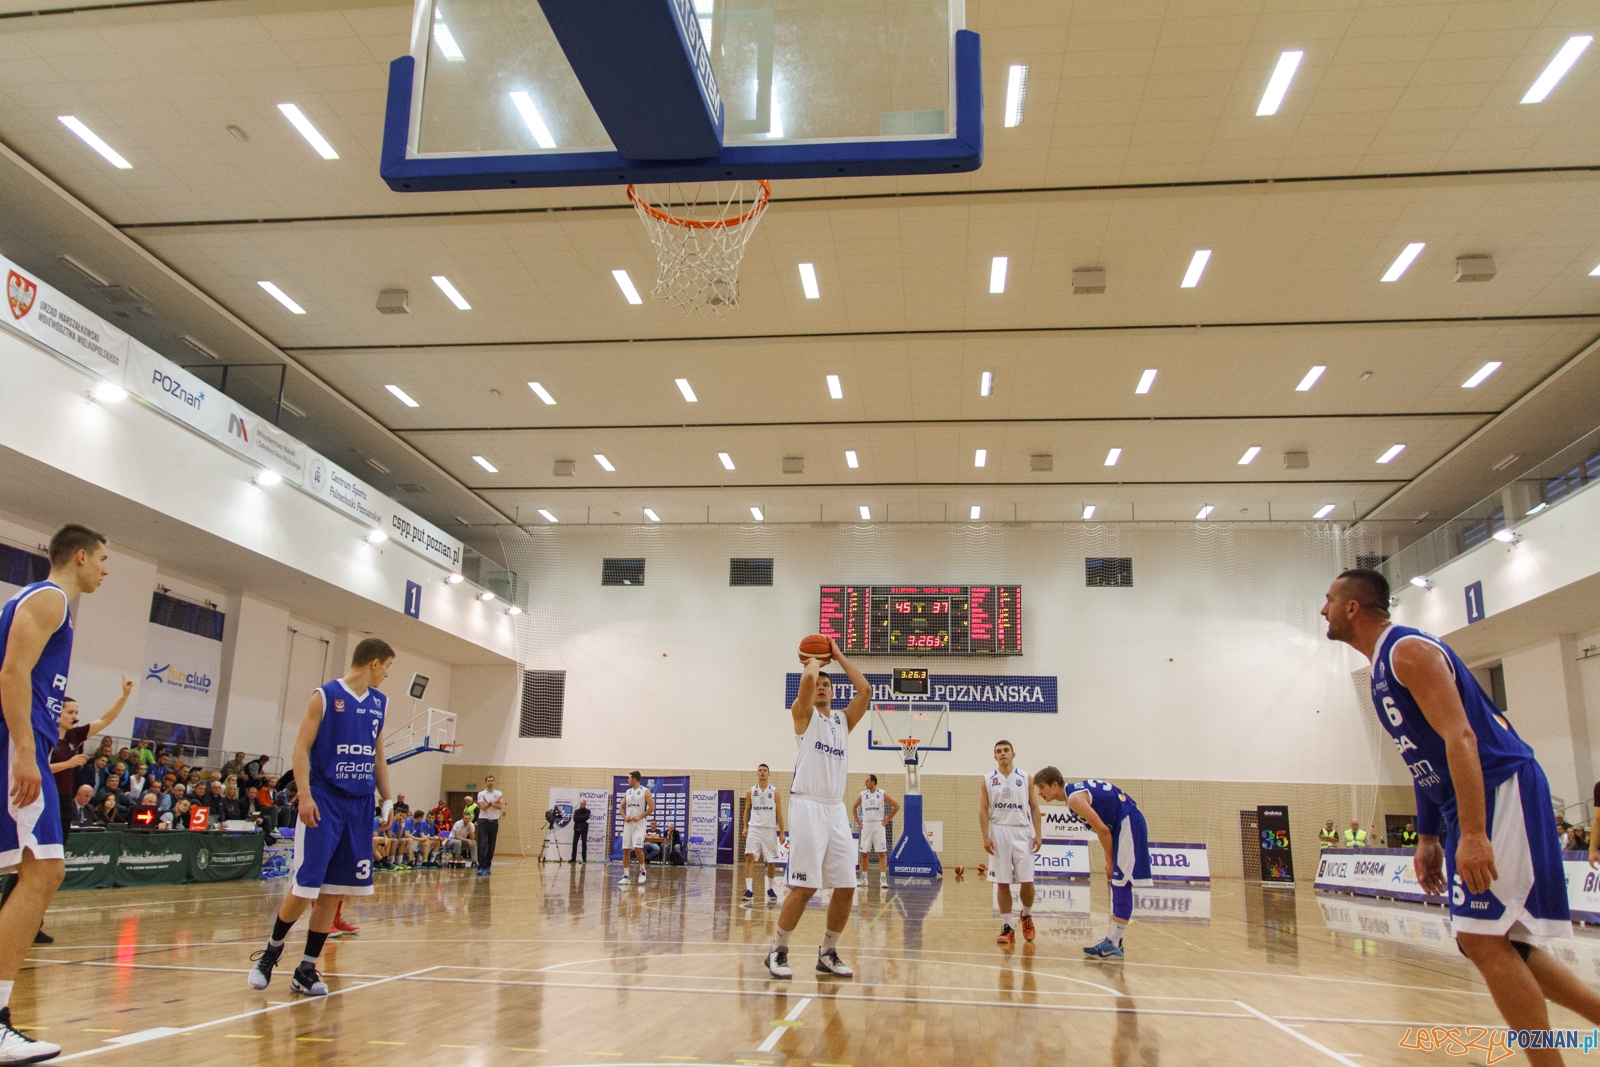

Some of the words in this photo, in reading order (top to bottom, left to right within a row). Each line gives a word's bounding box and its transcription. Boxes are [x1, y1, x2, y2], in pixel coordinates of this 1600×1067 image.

[38, 311, 76, 341] WOJEWÓDZTWA
[76, 333, 120, 366] WIELKOPOLSKIEGO
[58, 311, 100, 342] MARSZAŁKOWSKI
[331, 470, 352, 491] Centrum
[351, 483, 367, 500] Sportu
[329, 485, 357, 510] Politechniki
[392, 514, 460, 566] cspp.put.poznan.pl
[410, 586, 417, 614] 1
[895, 602, 911, 614] 45
[932, 602, 949, 614] 37
[1469, 587, 1479, 618] 1
[168, 665, 211, 688] funclub
[934, 682, 1045, 702] POZNAŃSKA
[1382, 696, 1403, 726] 6
[193, 808, 206, 825] 5
[1261, 829, 1289, 850] 35
[355, 858, 371, 880] 3
[1325, 862, 1349, 878] NICKEL
[1354, 861, 1386, 876] BIOFARM
